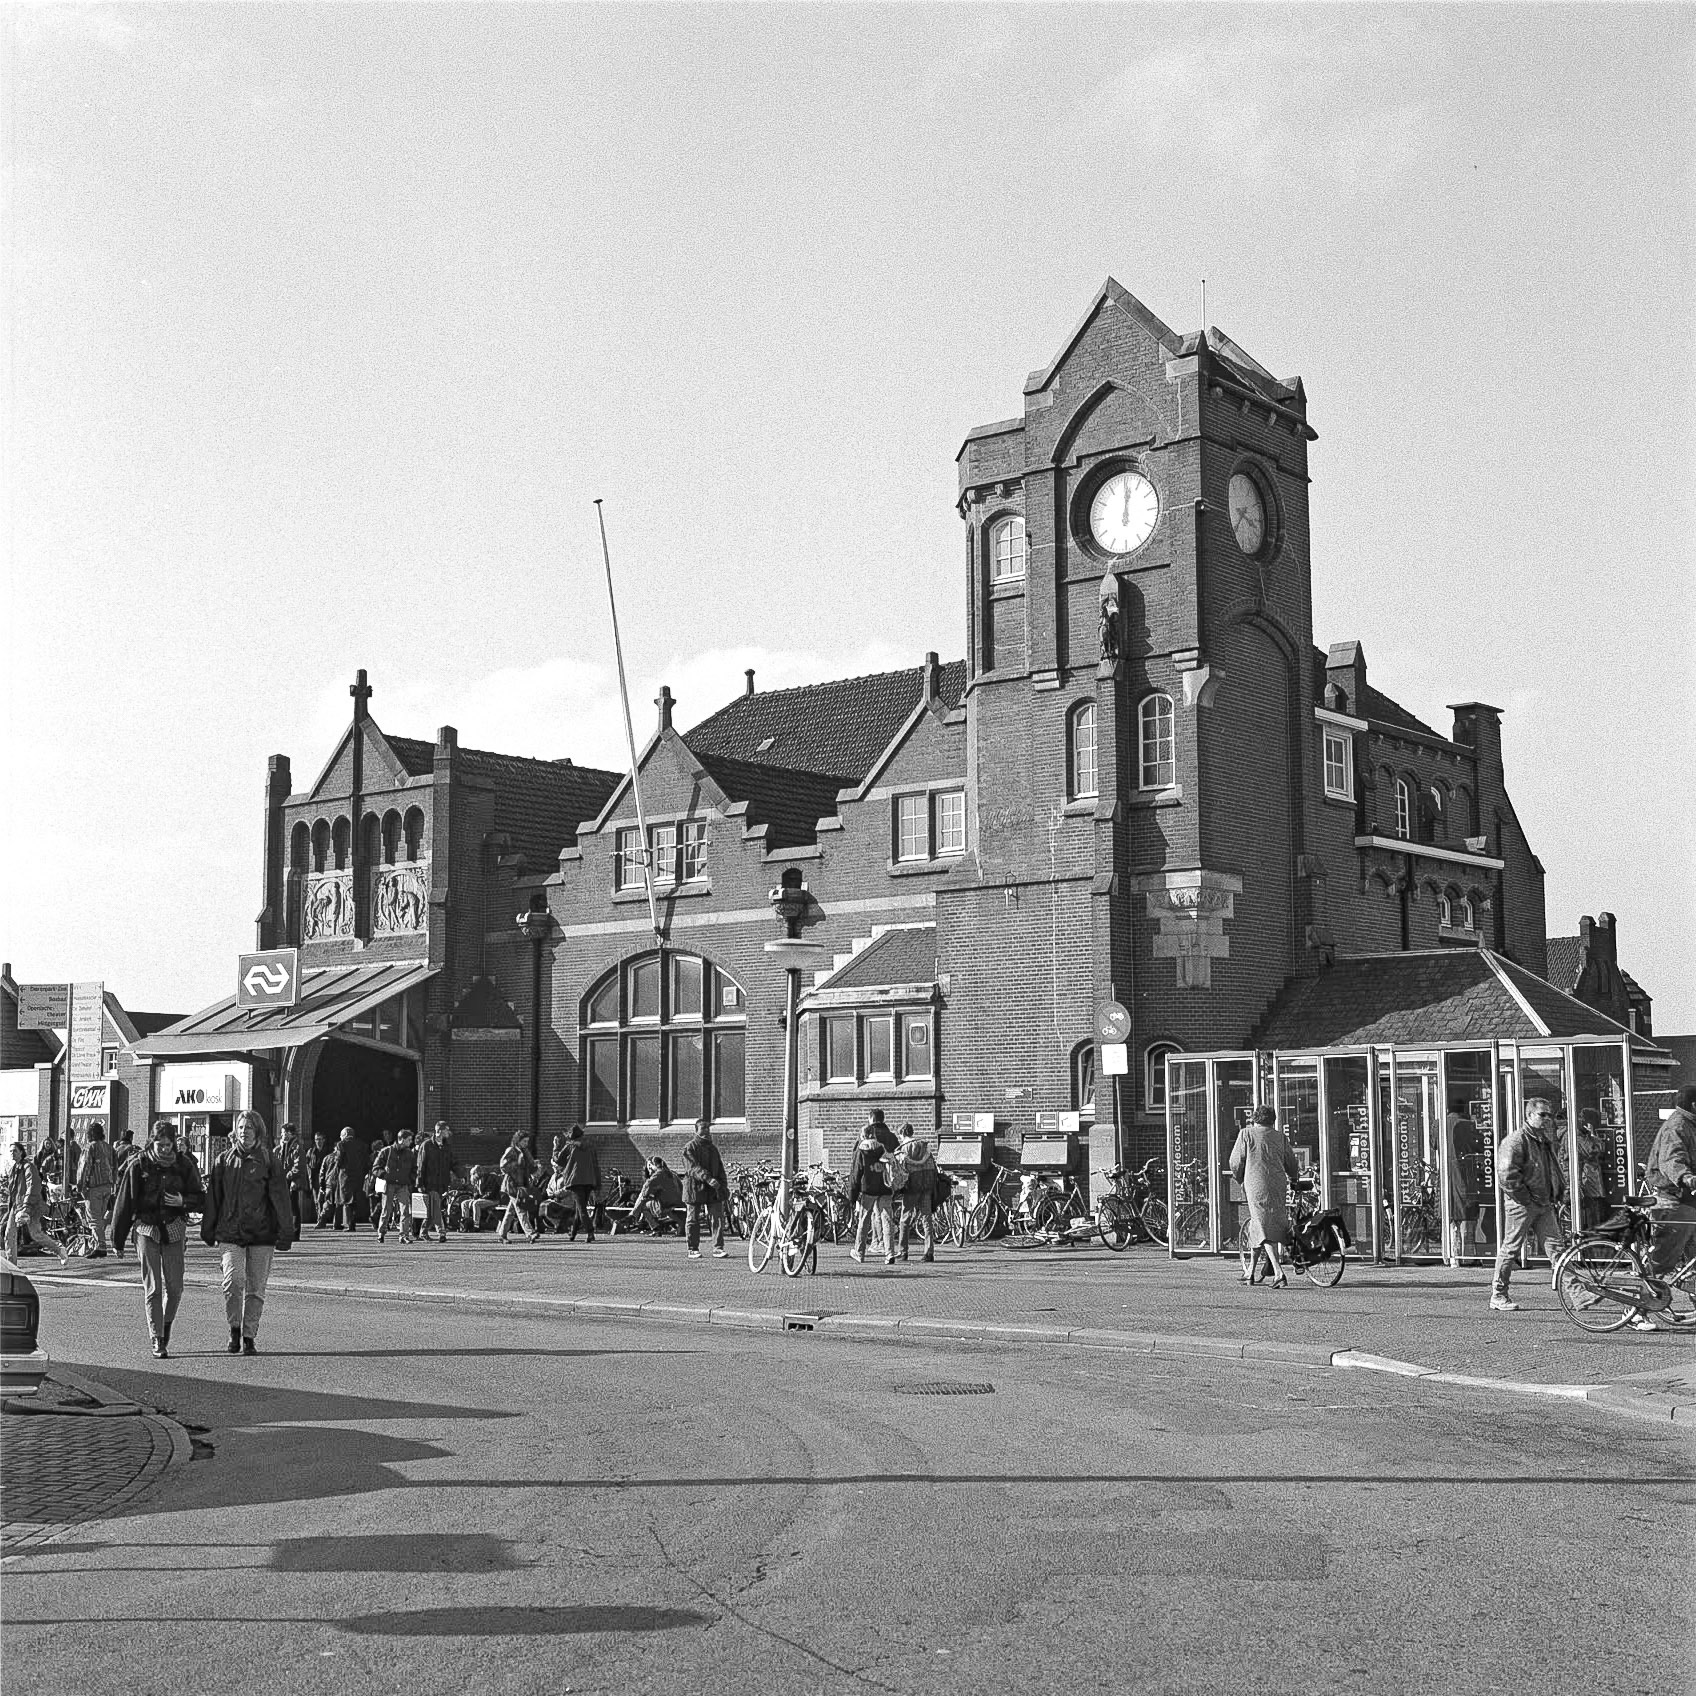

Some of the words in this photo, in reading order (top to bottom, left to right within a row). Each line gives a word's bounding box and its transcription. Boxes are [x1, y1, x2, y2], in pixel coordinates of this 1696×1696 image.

[73, 1089, 106, 1107] GWK
[175, 1089, 205, 1105] AKO
[1358, 1108, 1369, 1129] ptt
[1480, 1103, 1491, 1127] ptt
[1399, 1121, 1409, 1177] telecom
[1483, 1130, 1494, 1187] telecom
[1616, 1128, 1627, 1187] telecom
[1402, 1182, 1412, 1203] ptt
